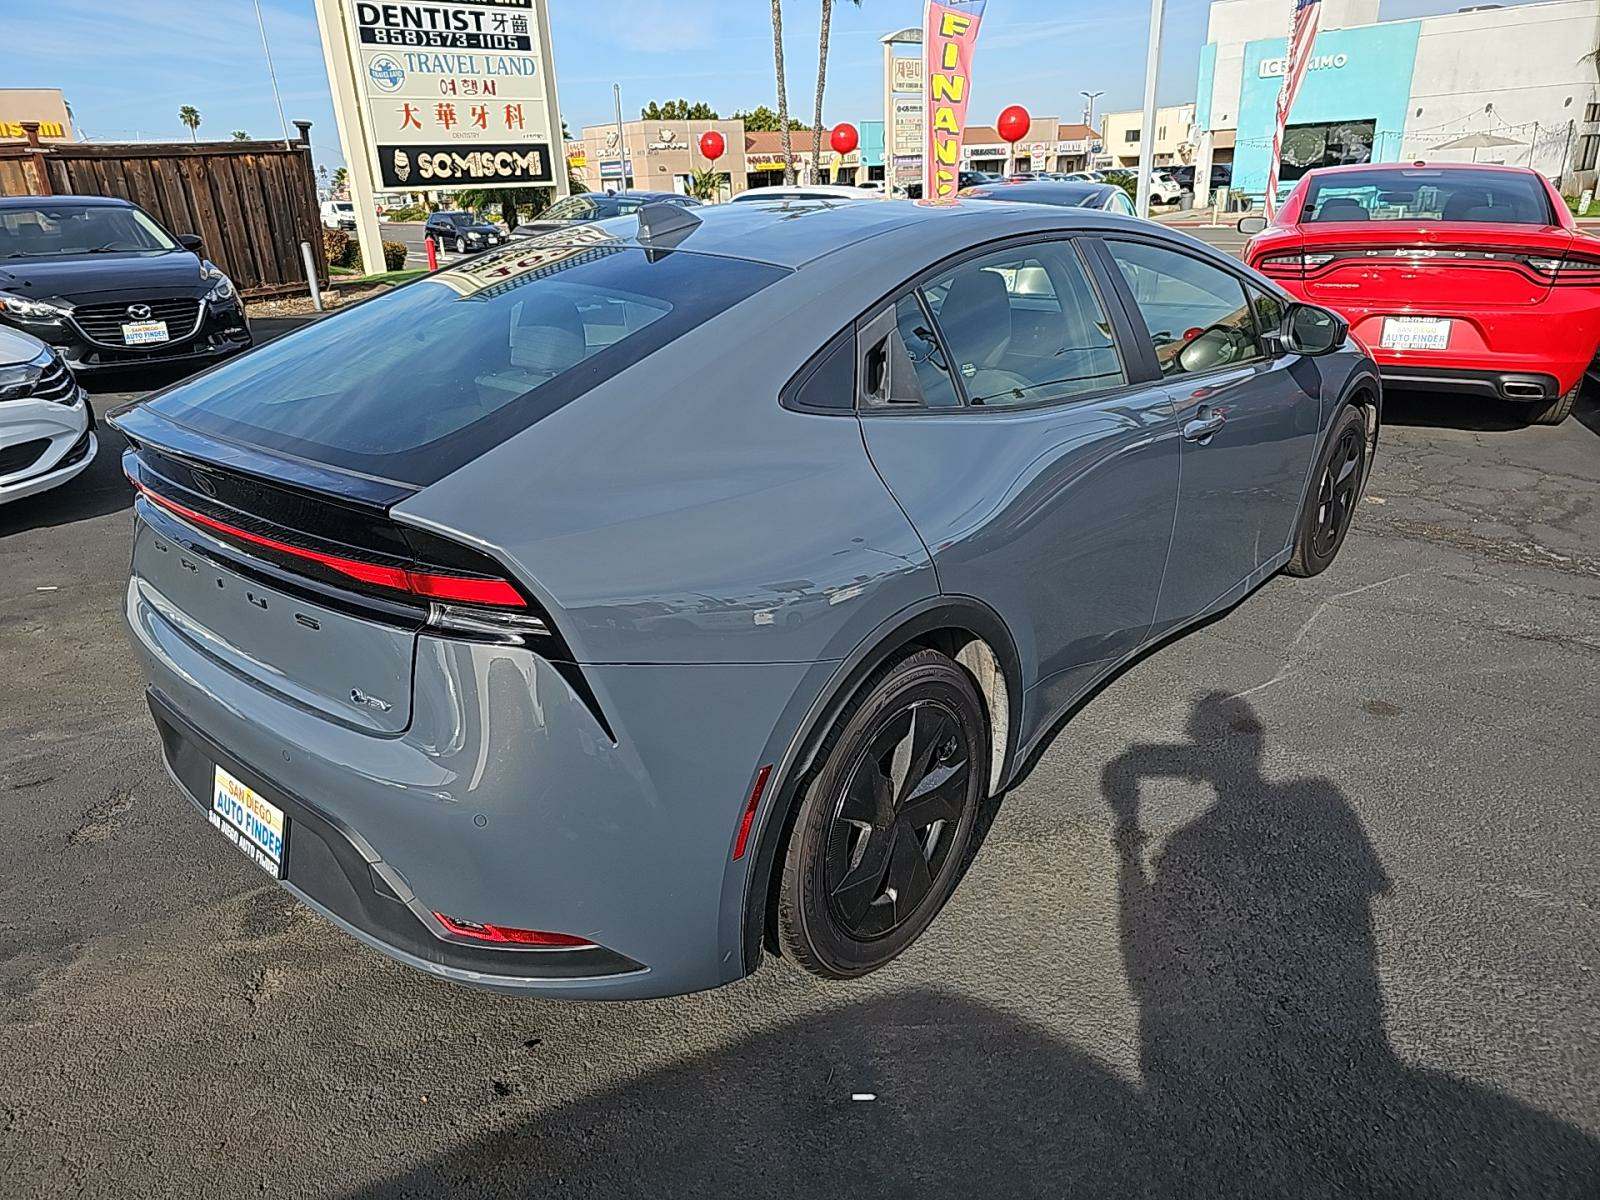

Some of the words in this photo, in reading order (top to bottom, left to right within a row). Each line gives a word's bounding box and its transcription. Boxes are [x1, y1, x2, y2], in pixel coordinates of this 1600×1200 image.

[356, 3, 486, 32] DENTIST
[491, 12, 529, 35] 牙齒
[374, 28, 519, 49] 858)573-1105
[403, 52, 480, 75] TRAVEL
[485, 55, 536, 76] LAND
[439, 78, 497, 96] 여행사
[395, 102, 526, 131] 大華牙科
[417, 150, 542, 179] SOMISOMI
[1385, 334, 1410, 342] AUTO
[1412, 334, 1446, 343] FINDER
[228, 780, 245, 803] SAN
[246, 793, 272, 824] DIEGO
[217, 790, 244, 824] AUTO
[245, 812, 282, 858] FINDER
[238, 835, 255, 858] AUTO
[255, 848, 279, 879] FINDER
